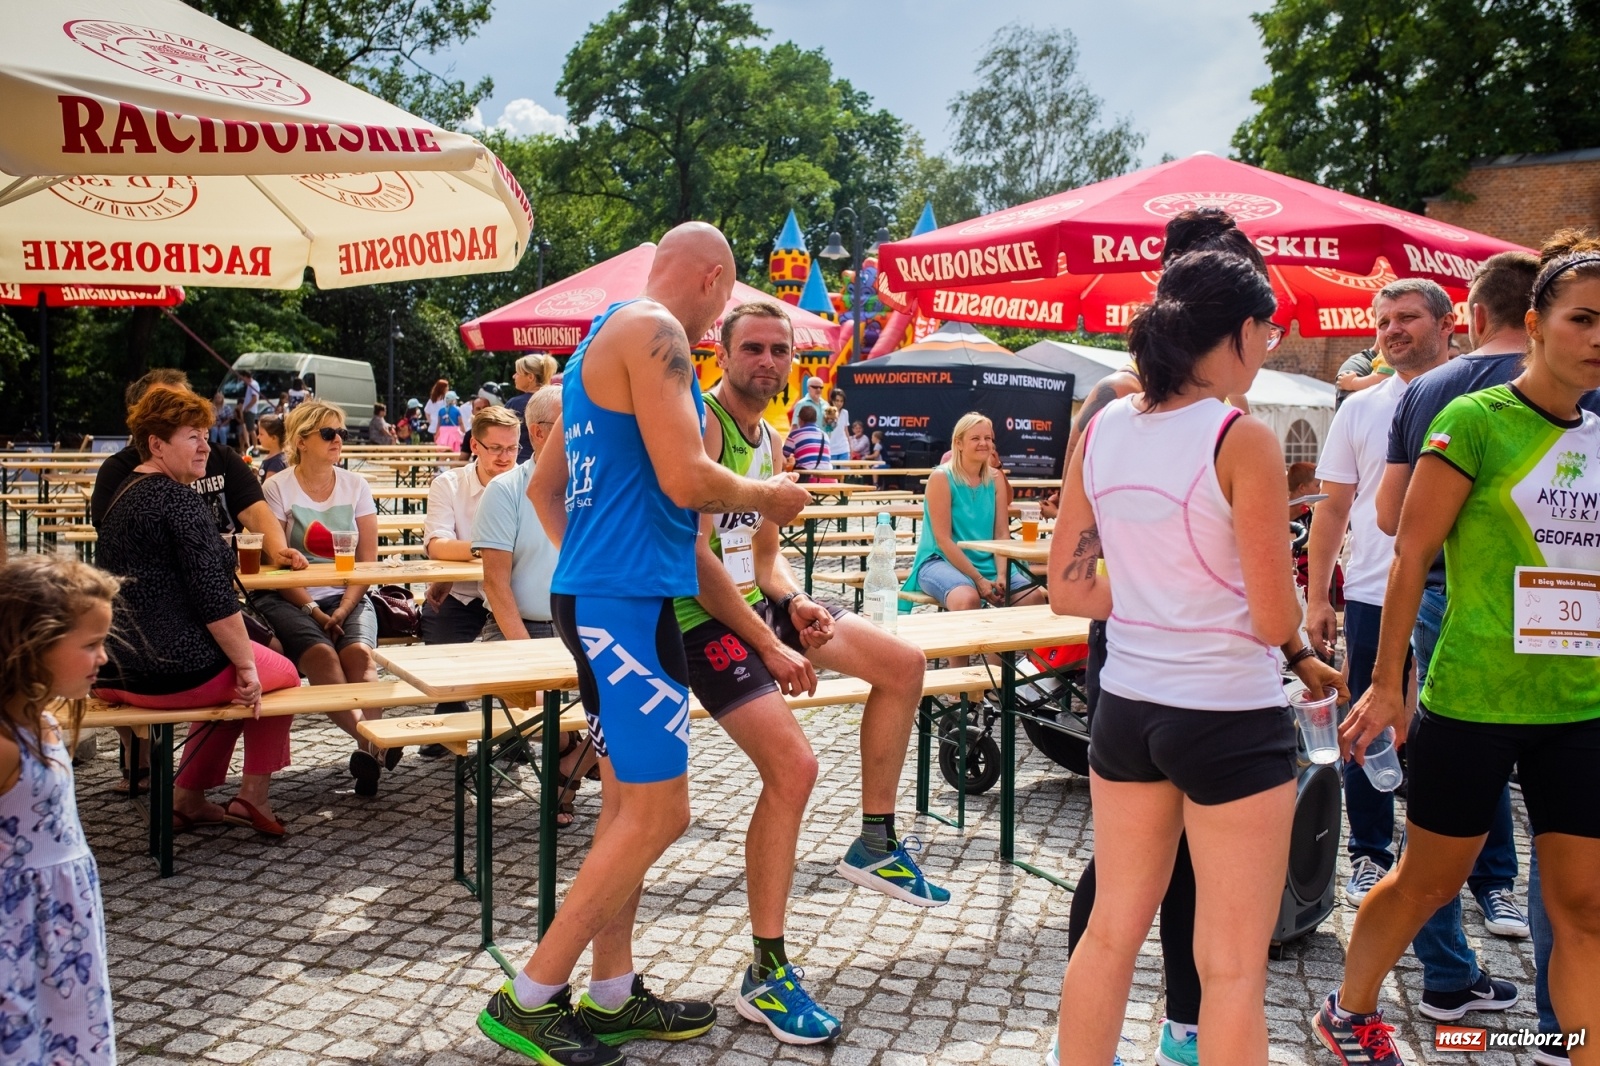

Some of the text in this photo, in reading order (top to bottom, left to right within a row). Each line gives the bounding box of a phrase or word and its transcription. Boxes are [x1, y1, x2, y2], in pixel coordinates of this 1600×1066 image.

[57, 94, 443, 155] RACIBORSKIE
[895, 241, 1042, 282] RACIBORSKIE
[853, 372, 953, 384] WWW.DIGITENT.PL
[983, 372, 1067, 392] SKLEP INTERNETOWY
[878, 416, 930, 428] DIGITENT
[1014, 419, 1052, 431] DIGITENT
[1551, 507, 1599, 520] LYSKI
[1538, 578, 1554, 587] Bieg
[1559, 600, 1582, 621] 30
[704, 633, 748, 671] 88
